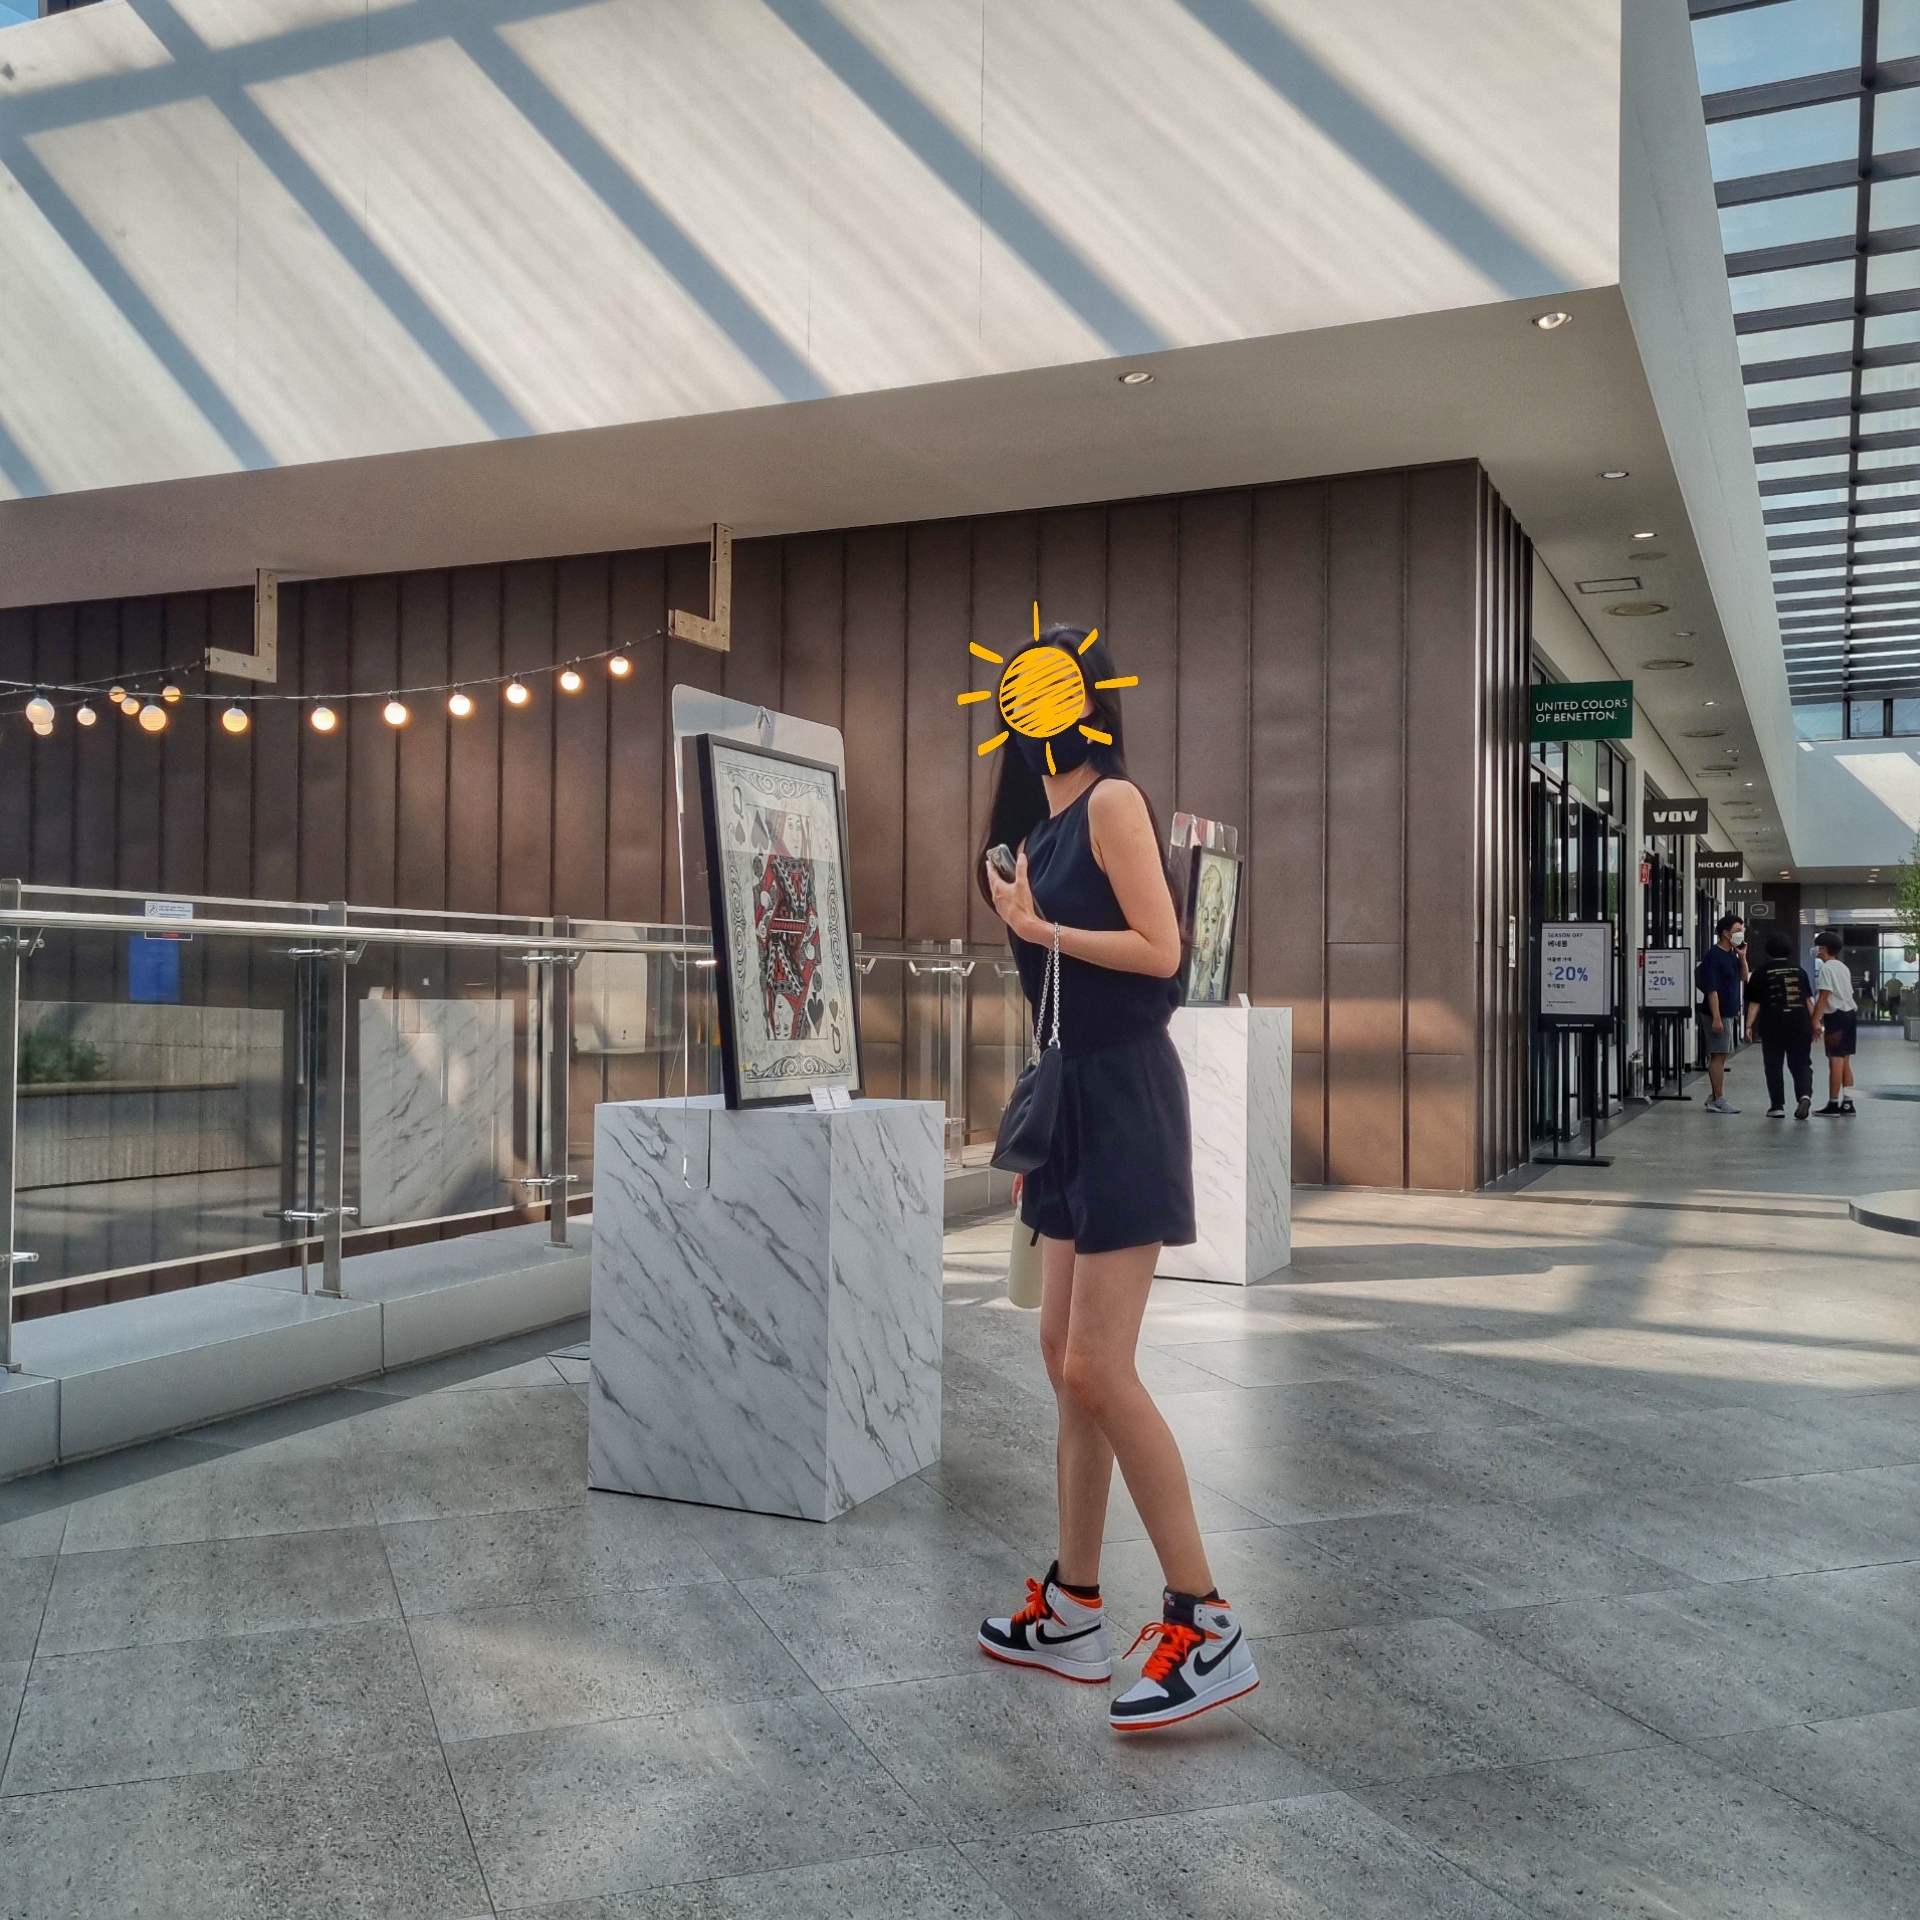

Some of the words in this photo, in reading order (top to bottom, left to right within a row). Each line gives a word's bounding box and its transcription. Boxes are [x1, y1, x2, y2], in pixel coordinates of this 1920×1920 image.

[1535, 701, 1579, 712] UNITED
[1581, 698, 1628, 710] COLORS
[1535, 713, 1552, 723] OF
[1553, 710, 1618, 722] BENETTON.
[1652, 810, 1699, 823] VOV
[1547, 966, 1588, 982] +20%
